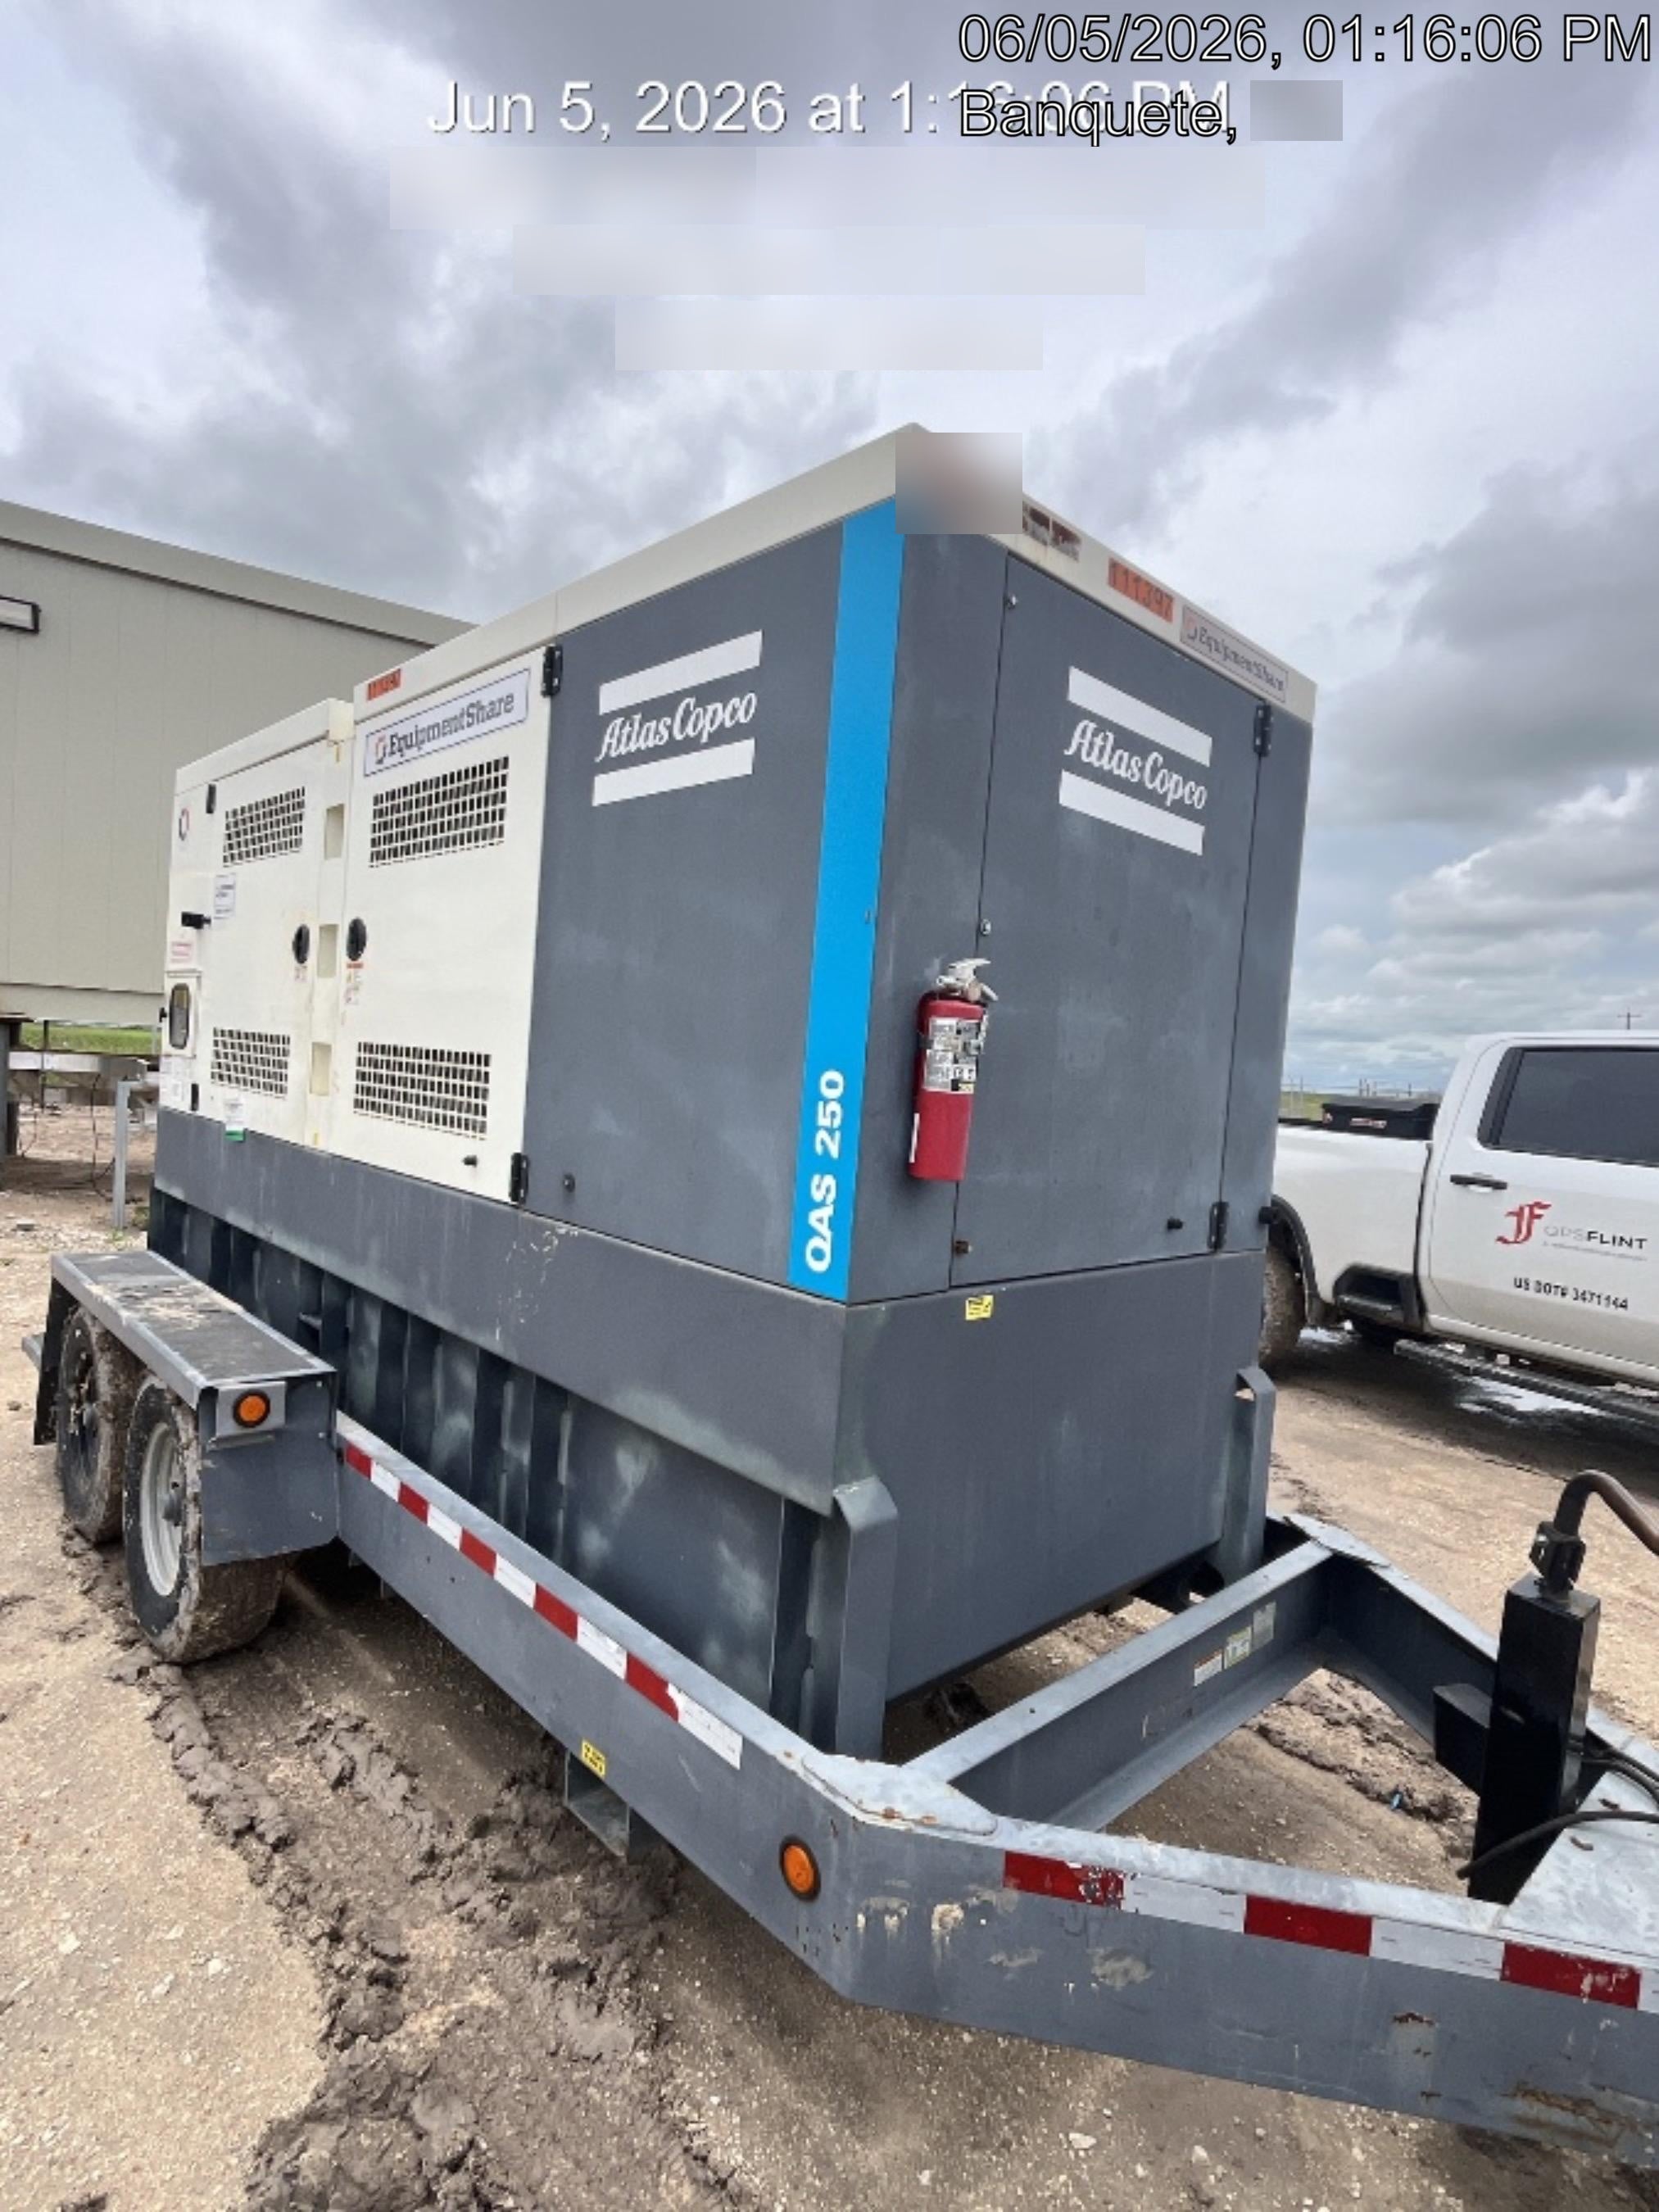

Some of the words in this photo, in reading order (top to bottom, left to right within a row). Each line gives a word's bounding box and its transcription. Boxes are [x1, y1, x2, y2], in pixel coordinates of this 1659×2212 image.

[388, 693, 514, 758] EquipmentShare
[595, 712, 672, 763] Atlas
[673, 691, 758, 744] Copco
[1063, 719, 1142, 782] Atlas
[1144, 751, 1208, 809] Copco
[815, 1069, 845, 1159] 250
[805, 1173, 837, 1273] QAS
[1513, 1276, 1530, 1292] US
